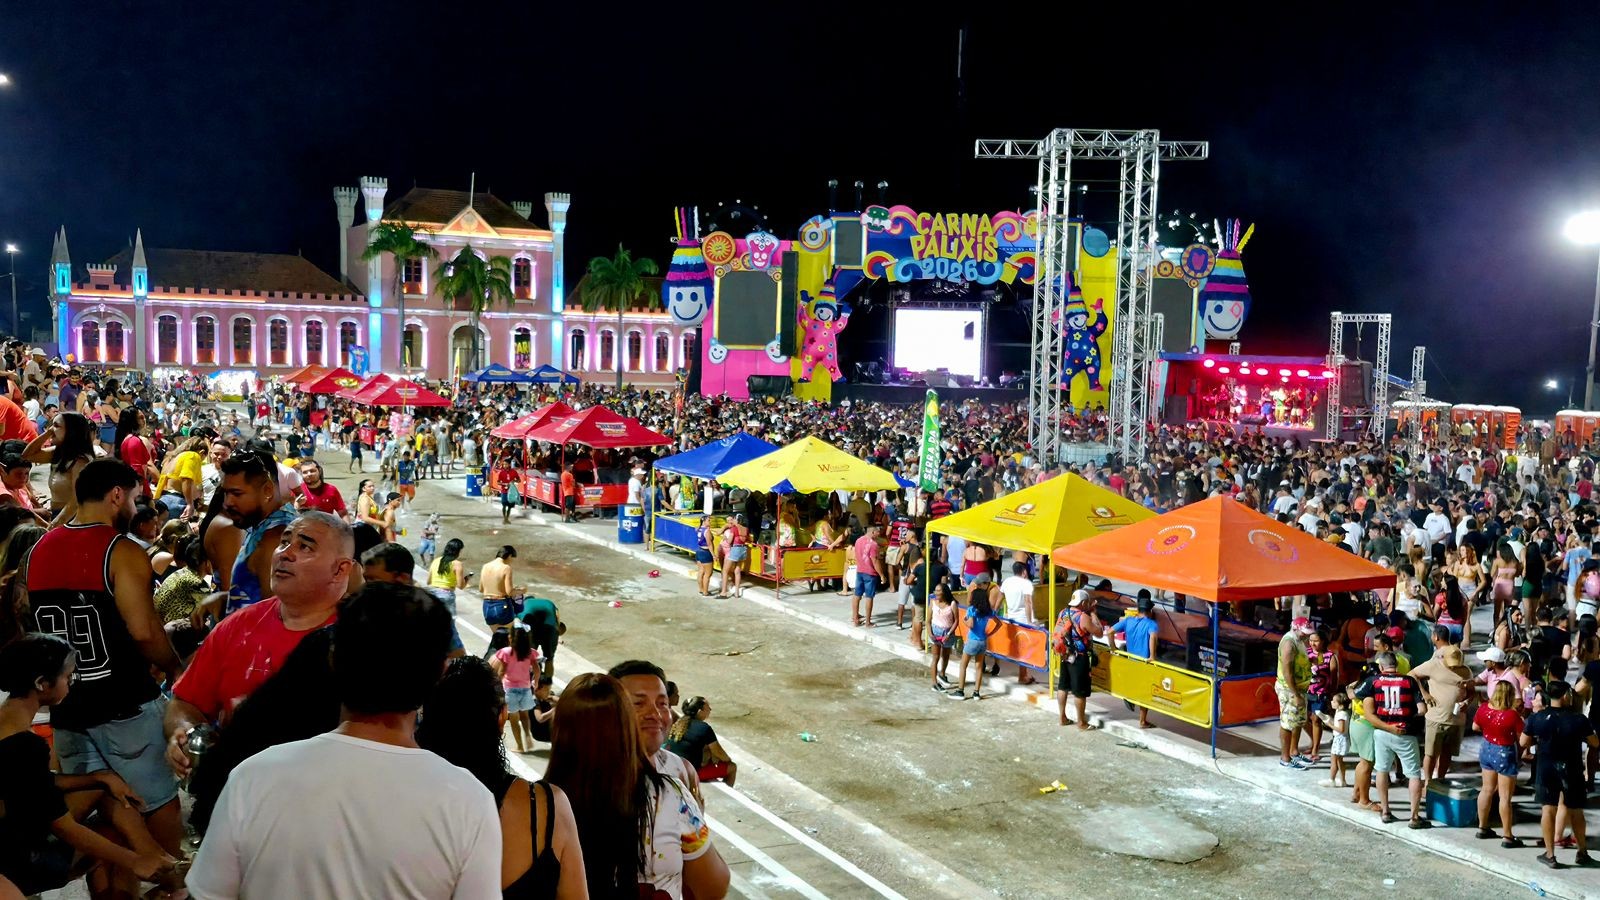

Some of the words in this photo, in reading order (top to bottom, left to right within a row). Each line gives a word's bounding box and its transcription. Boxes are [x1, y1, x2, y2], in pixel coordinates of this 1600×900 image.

[916, 212, 994, 236] CARNA
[921, 257, 979, 284] 2026
[927, 430, 939, 444] DA
[923, 447, 936, 480] SERRA
[1381, 685, 1401, 709] 10
